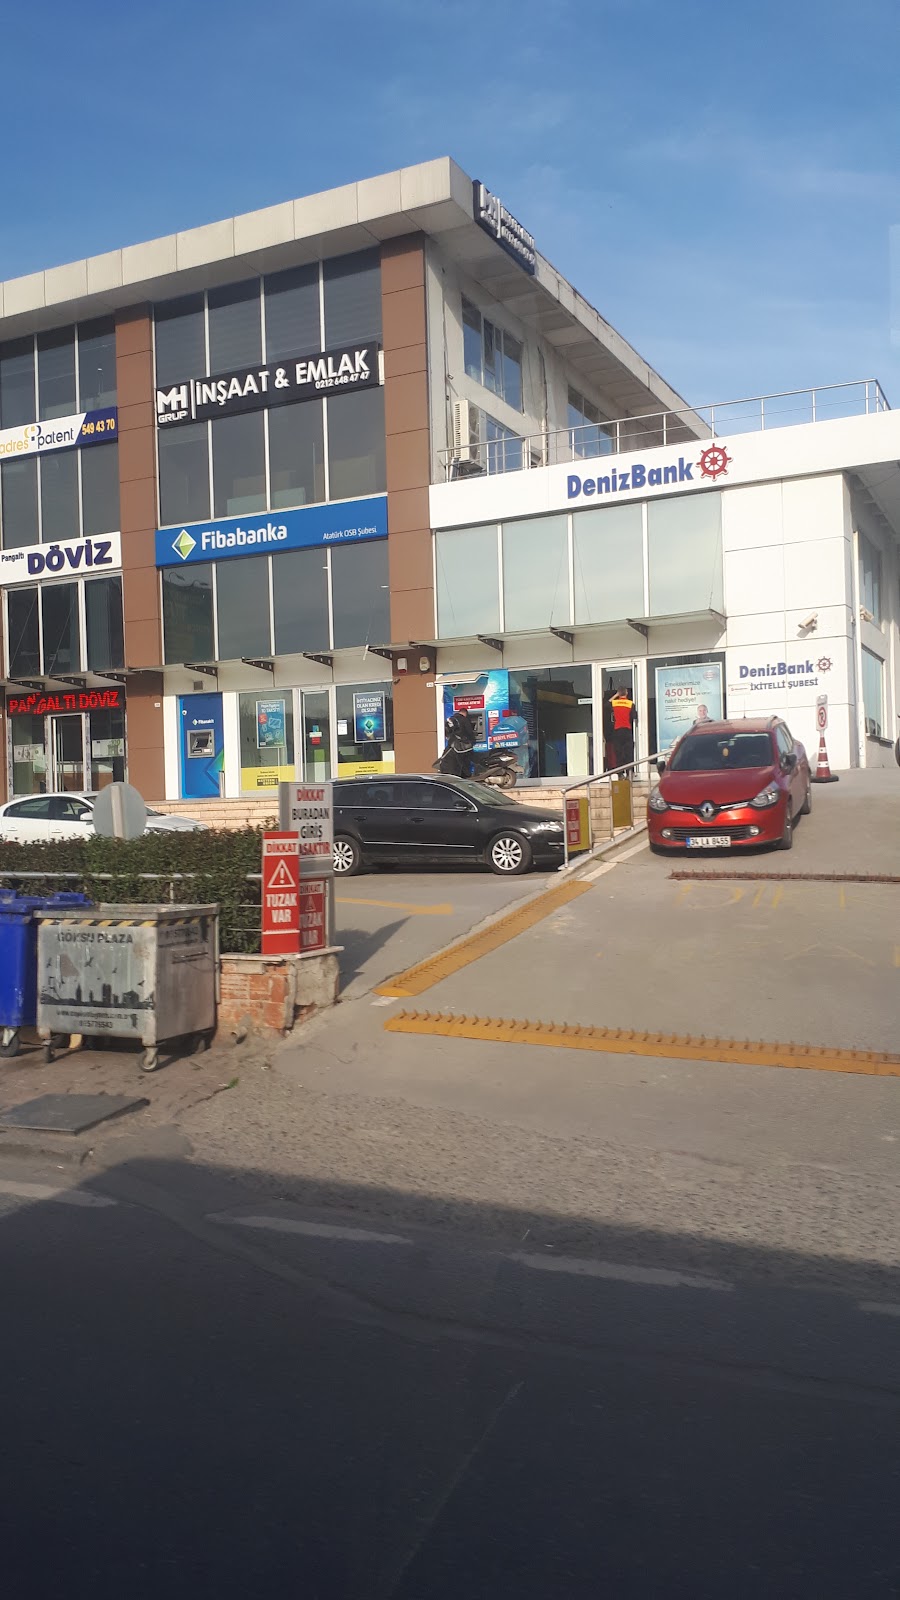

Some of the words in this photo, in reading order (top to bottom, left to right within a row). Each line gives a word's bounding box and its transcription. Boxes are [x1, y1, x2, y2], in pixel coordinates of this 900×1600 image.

[195, 371, 269, 406] İNŞAAT
[274, 367, 290, 389] &
[295, 349, 370, 385] EMLAK
[315, 378, 334, 390] 0212
[334, 375, 348, 386] 648
[349, 373, 360, 382] 47
[360, 370, 371, 381] 47
[157, 384, 188, 414] MH
[158, 410, 188, 424] GRUP
[0, 439, 29, 455] adres
[37, 428, 75, 450] patent
[81, 422, 95, 436] 549
[95, 420, 105, 432] 43
[106, 418, 116, 430] 70
[567, 457, 694, 499] DenizBank
[201, 522, 288, 551] Fibabanka
[322, 530, 344, 541] Atatürk
[343, 528, 357, 538] OSB
[357, 525, 378, 537] Şubesi
[27, 539, 113, 575] DÖVİZ
[739, 660, 814, 679] DenizBank
[750, 680, 786, 691] İKİTELLİ
[787, 677, 819, 690] ŞUBESİ
[78, 690, 119, 709] DÖVİZ
[664, 688, 683, 698] 450
[684, 687, 696, 697] TL
[296, 787, 325, 802] DİKKAT
[292, 808, 330, 820] BURADAN
[300, 822, 323, 841] GİRİŞ
[266, 841, 297, 853] DİKKAT
[691, 837, 699, 846] 34
[266, 893, 297, 907] TUZAK
[271, 910, 292, 923] VAR
[97, 933, 134, 943] PLAZA
